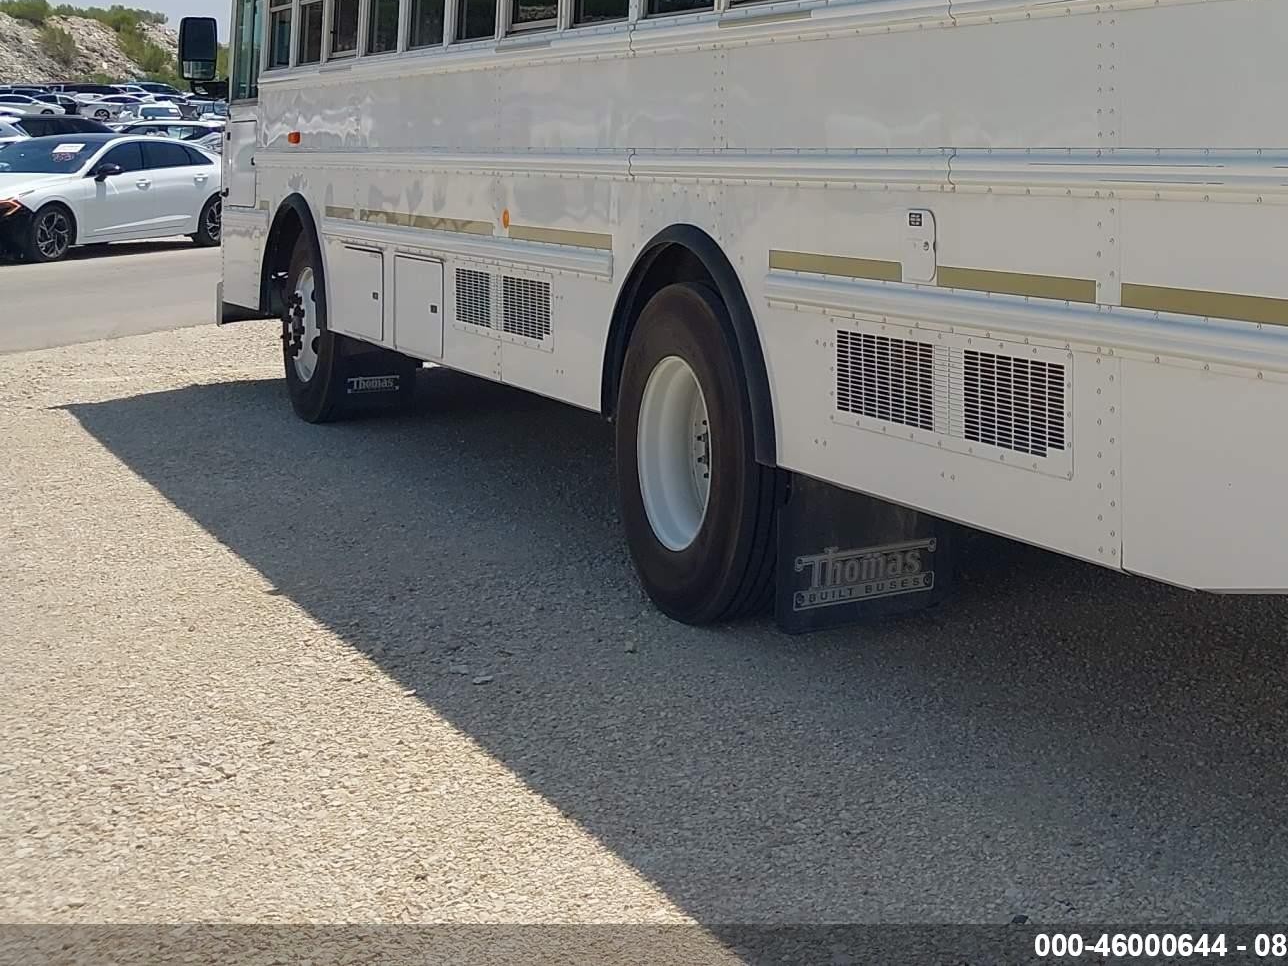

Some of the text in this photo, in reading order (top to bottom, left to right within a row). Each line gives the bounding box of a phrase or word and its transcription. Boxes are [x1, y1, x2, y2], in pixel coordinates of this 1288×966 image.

[800, 543, 929, 589] Thomas
[808, 575, 921, 603] BUILT BUSES
